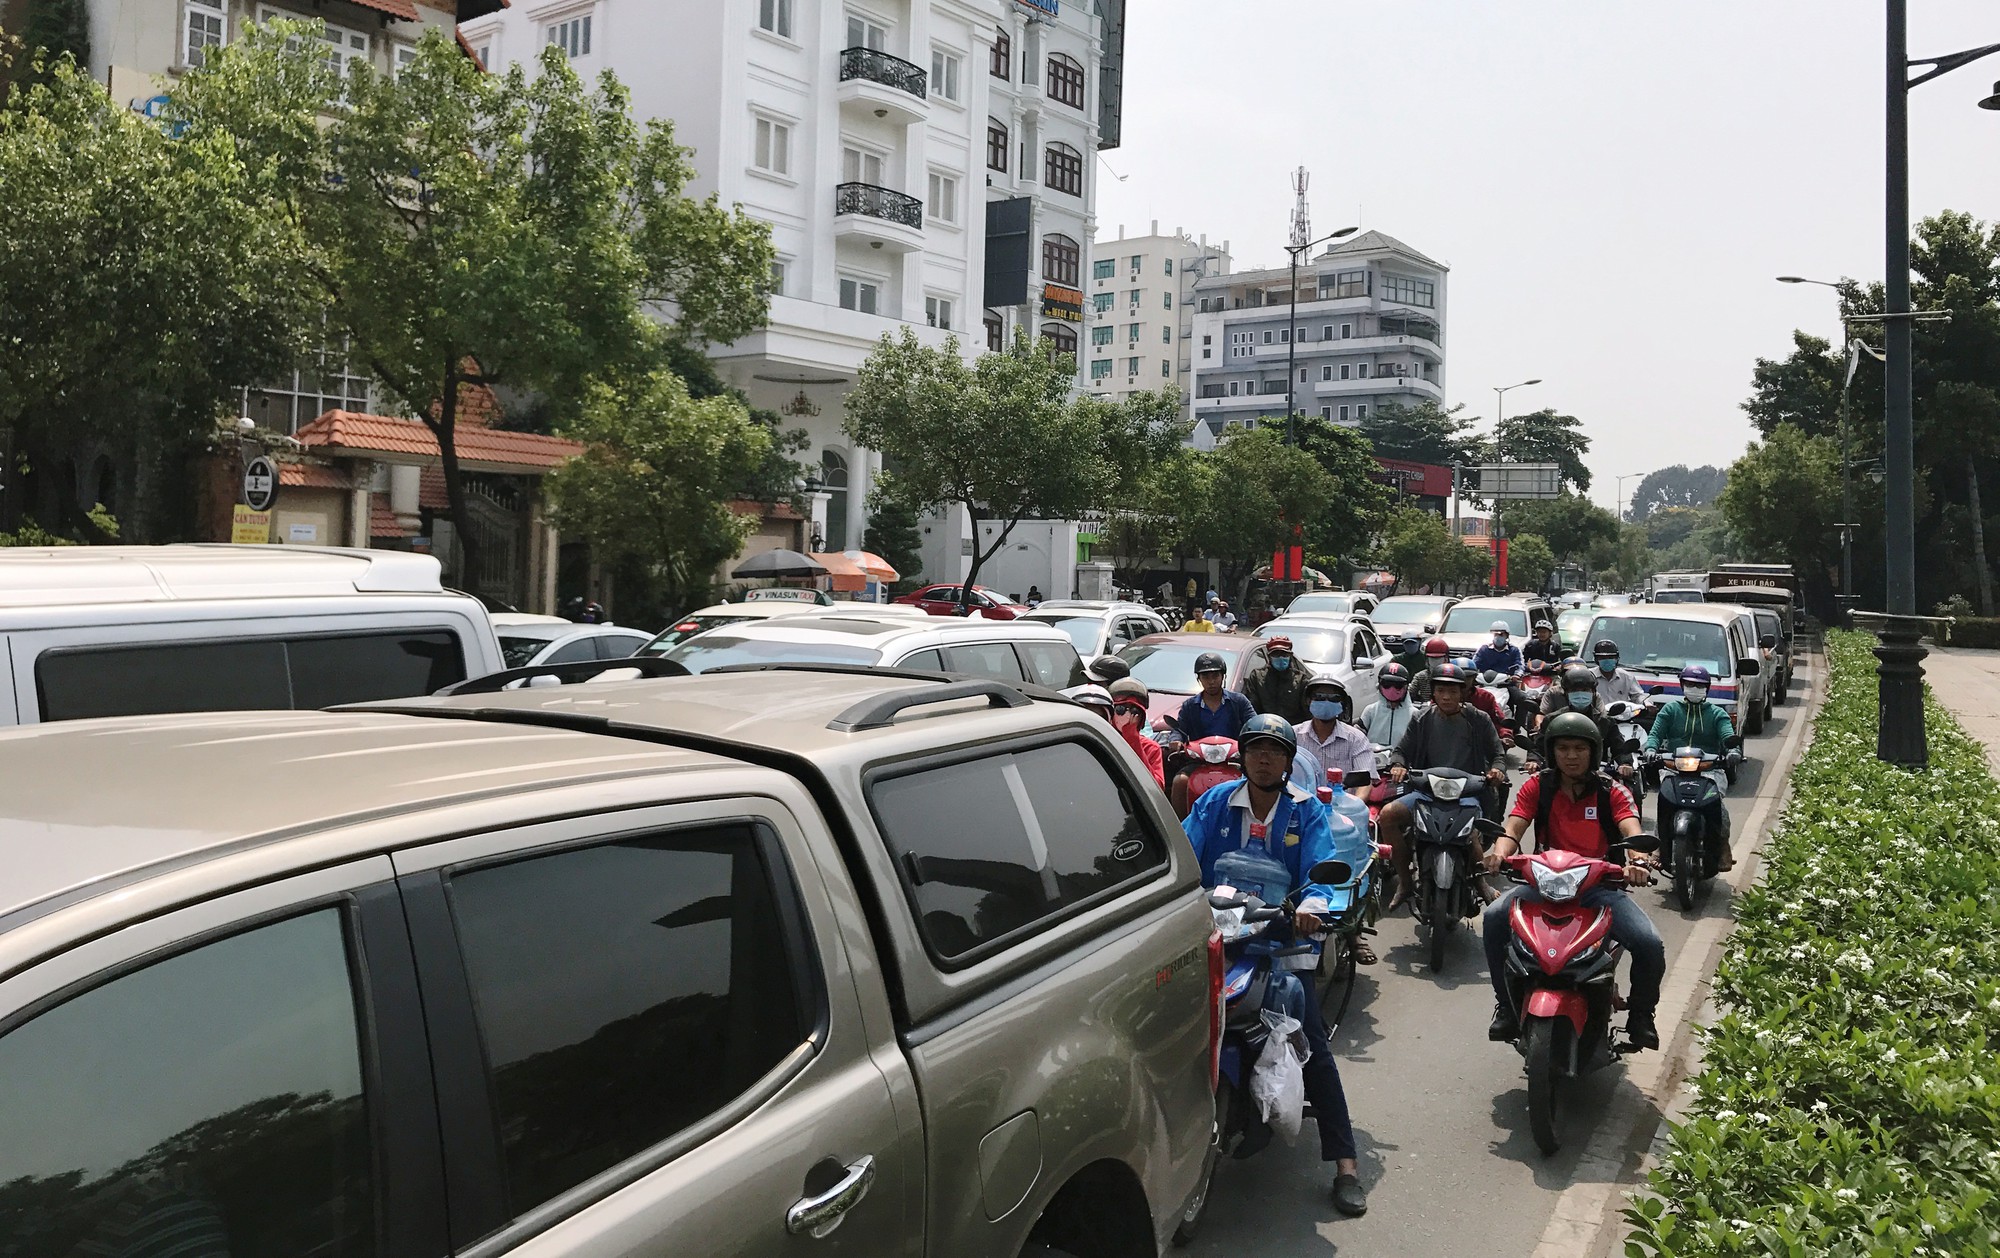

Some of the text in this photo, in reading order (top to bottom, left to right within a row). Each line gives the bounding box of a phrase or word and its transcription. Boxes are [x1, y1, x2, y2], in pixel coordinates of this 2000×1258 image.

[1728, 578, 1775, 587] XE THƯ BÁO
[765, 591, 815, 600] VINASUN TAXI
